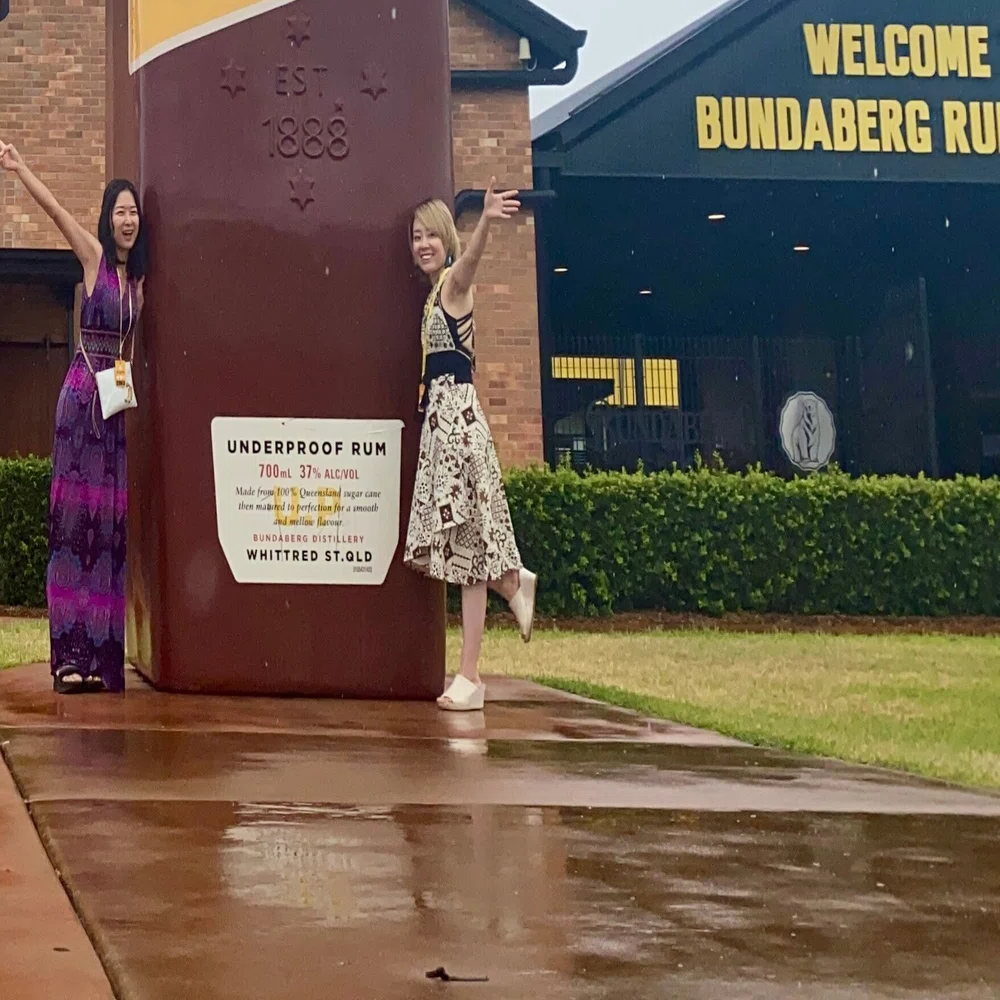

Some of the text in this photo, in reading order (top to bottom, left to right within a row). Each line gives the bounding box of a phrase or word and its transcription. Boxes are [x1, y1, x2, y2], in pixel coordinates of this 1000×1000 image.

[803, 23, 991, 78] WELCOME
[696, 96, 1000, 154] BUNDABERG RU
[261, 116, 350, 161] 1888
[227, 440, 387, 456] UNDERPROOF RUM
[258, 464, 360, 480] 700mL 37% ALC/VOL
[235, 486, 256, 496] Made
[257, 486, 275, 498] from
[299, 486, 342, 499] Queensland
[343, 489, 363, 499] sugar
[364, 490, 381, 498] cane
[238, 502, 254, 511] then
[255, 502, 285, 511] matured
[287, 502, 295, 511] to
[296, 501, 332, 514] perfection
[333, 502, 345, 514] for
[352, 502, 379, 512] smooth
[273, 516, 287, 526] and
[289, 516, 315, 526] mellow
[253, 534, 365, 544] BUNDABERG DISTILLERY
[246, 549, 318, 561] WHITTRED
